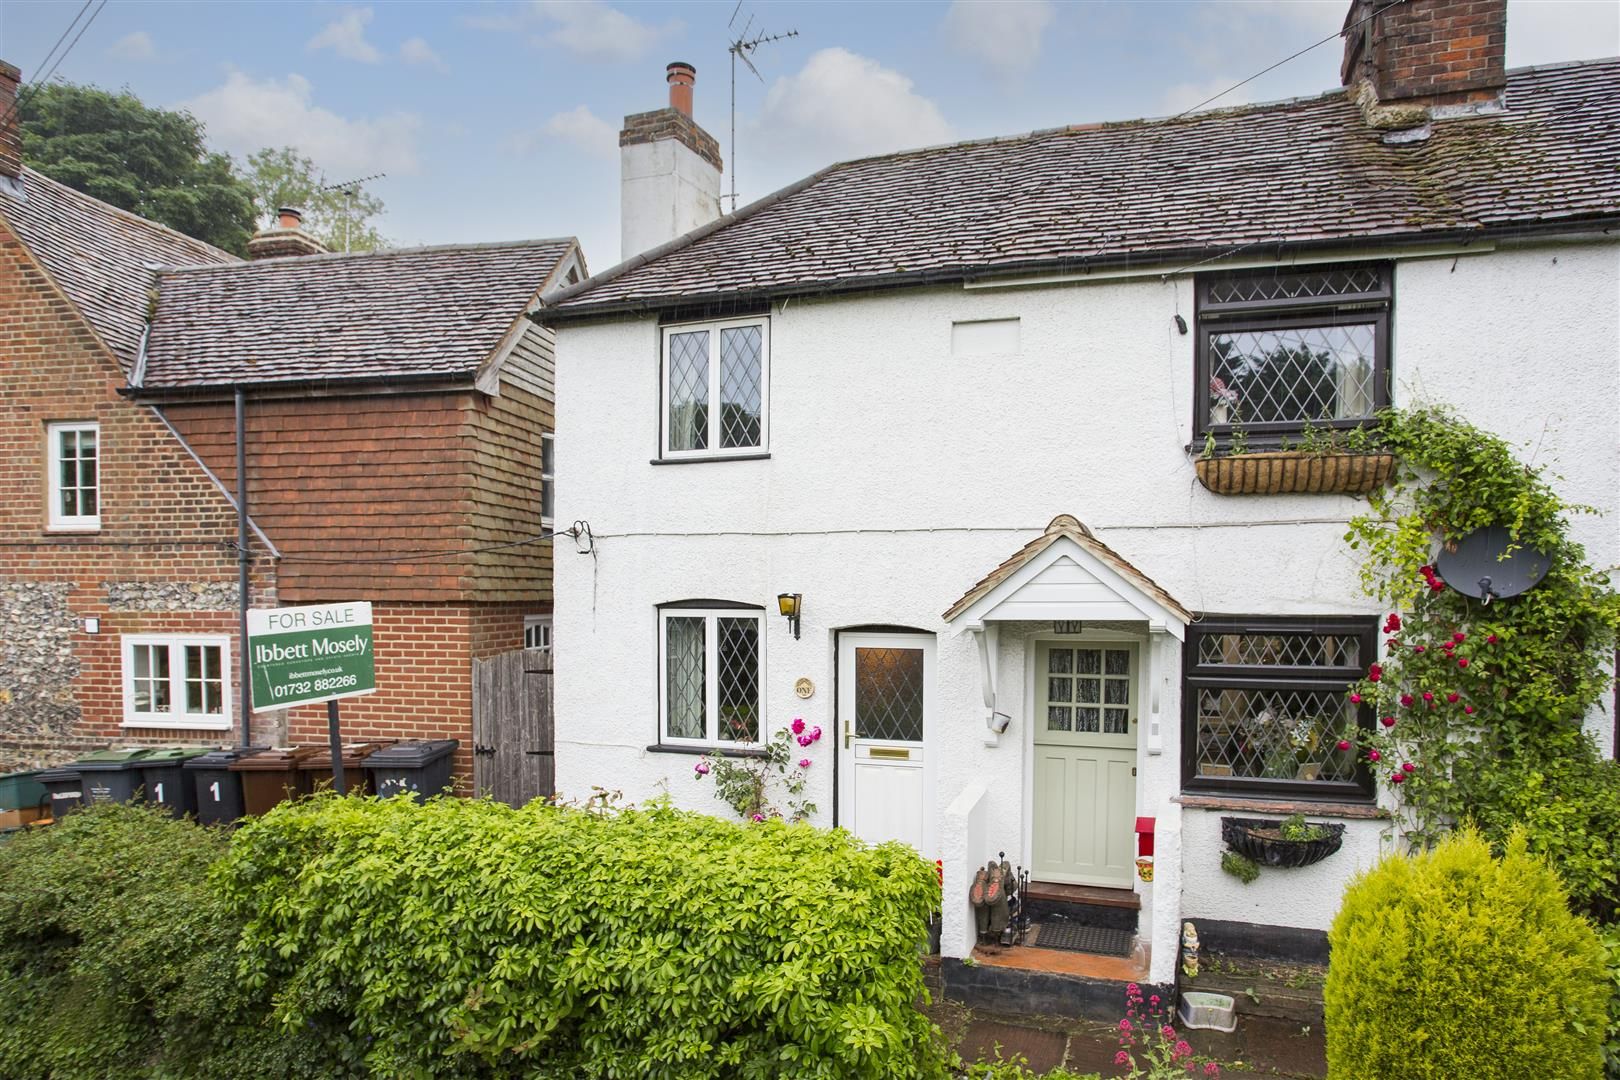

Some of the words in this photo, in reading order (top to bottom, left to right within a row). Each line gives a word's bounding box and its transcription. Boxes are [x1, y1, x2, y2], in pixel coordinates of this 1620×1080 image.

[268, 612, 306, 630] FOR
[312, 608, 354, 626] SALE
[255, 643, 309, 663] Ibbett
[312, 634, 368, 656] Mosely
[274, 681, 311, 698] 01732
[314, 674, 357, 692] 882266
[154, 783, 164, 803] 1
[209, 781, 221, 801] 1
